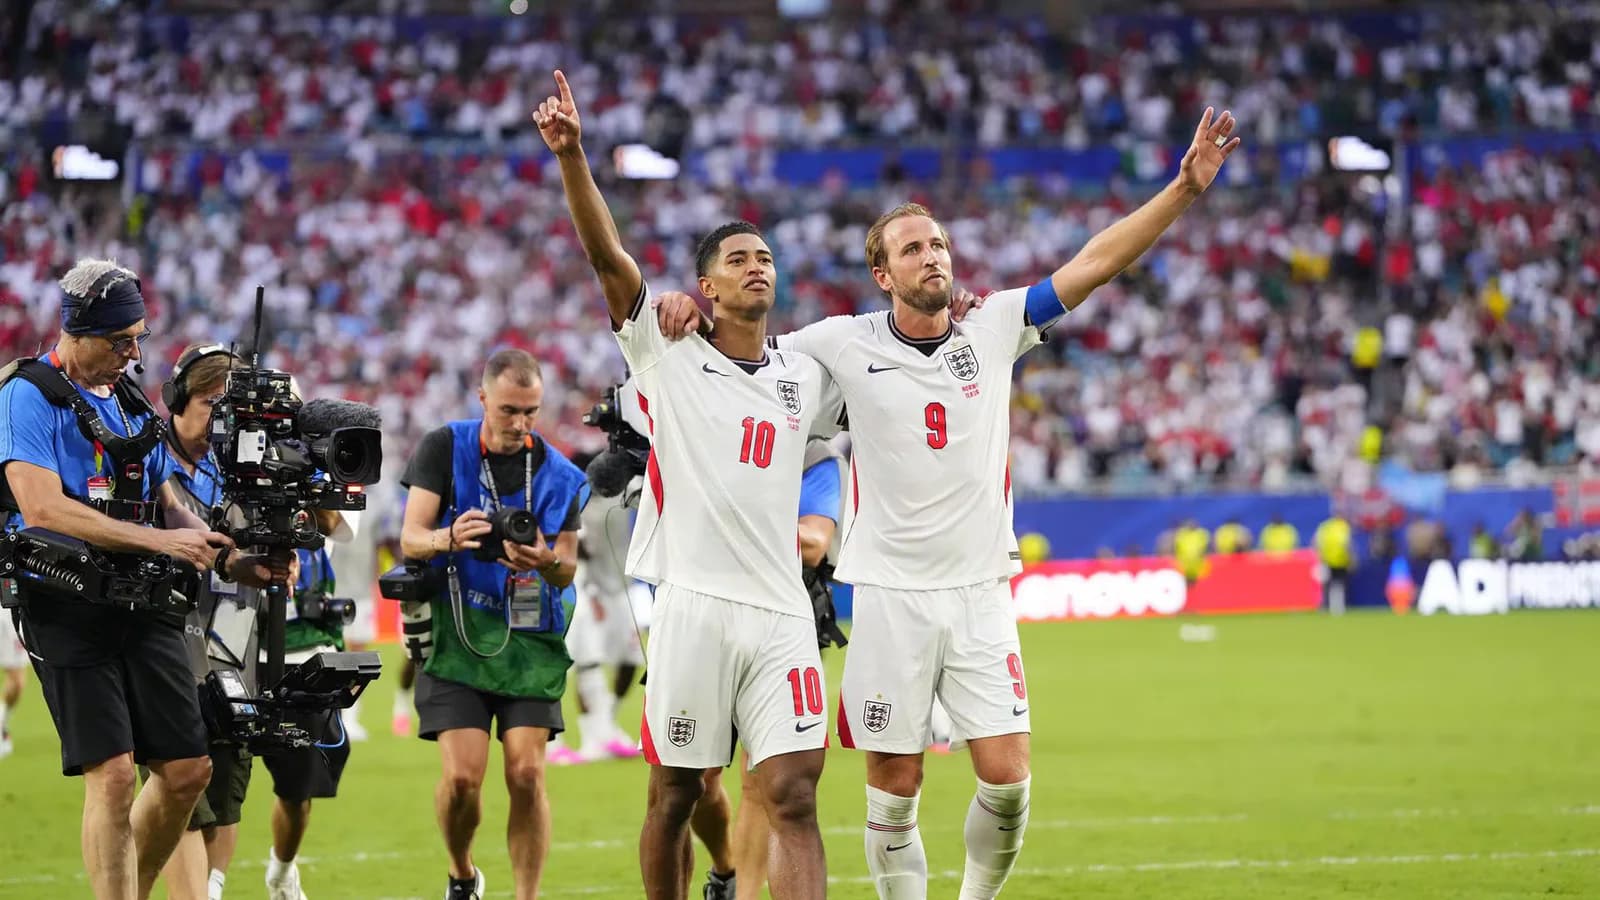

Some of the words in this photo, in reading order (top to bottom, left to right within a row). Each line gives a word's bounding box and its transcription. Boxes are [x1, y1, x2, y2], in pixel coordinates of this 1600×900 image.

[739, 416, 776, 469] 10
[924, 402, 948, 450] 9
[1014, 569, 1187, 620] enovo
[787, 666, 823, 716] 10
[1006, 652, 1025, 700] 9
